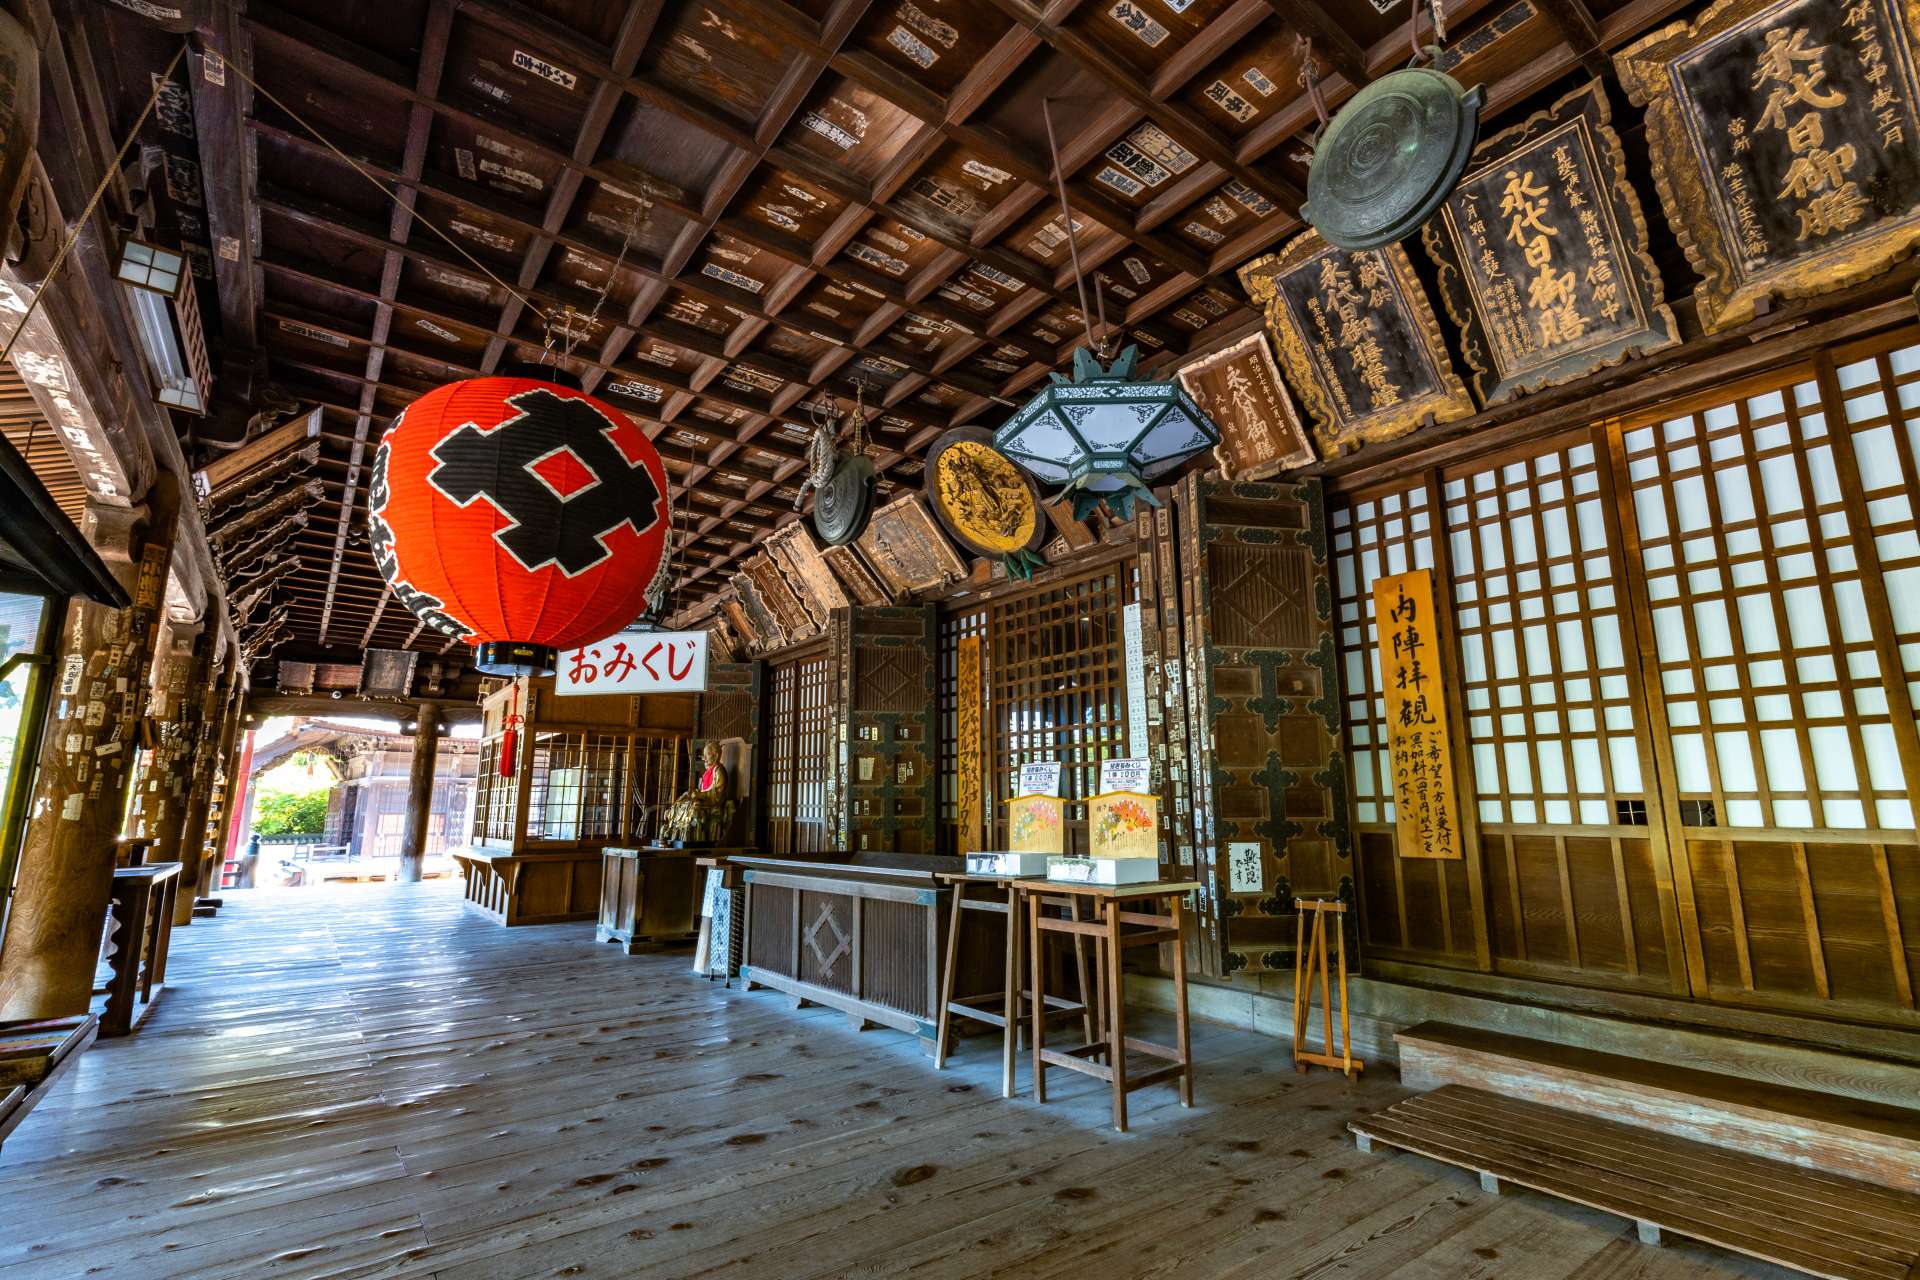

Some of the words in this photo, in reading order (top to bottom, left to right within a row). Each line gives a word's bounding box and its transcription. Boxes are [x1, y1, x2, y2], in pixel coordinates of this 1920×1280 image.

[1751, 26, 1872, 242] 永代日御膳
[1499, 170, 1591, 349] 永代日御膳
[1225, 364, 1279, 463] 永代日御膳
[568, 641, 697, 685] おみくじ
[1390, 583, 1437, 729] 内陣拝観
[1425, 729, 1453, 855] ご希望の方は受付へ
